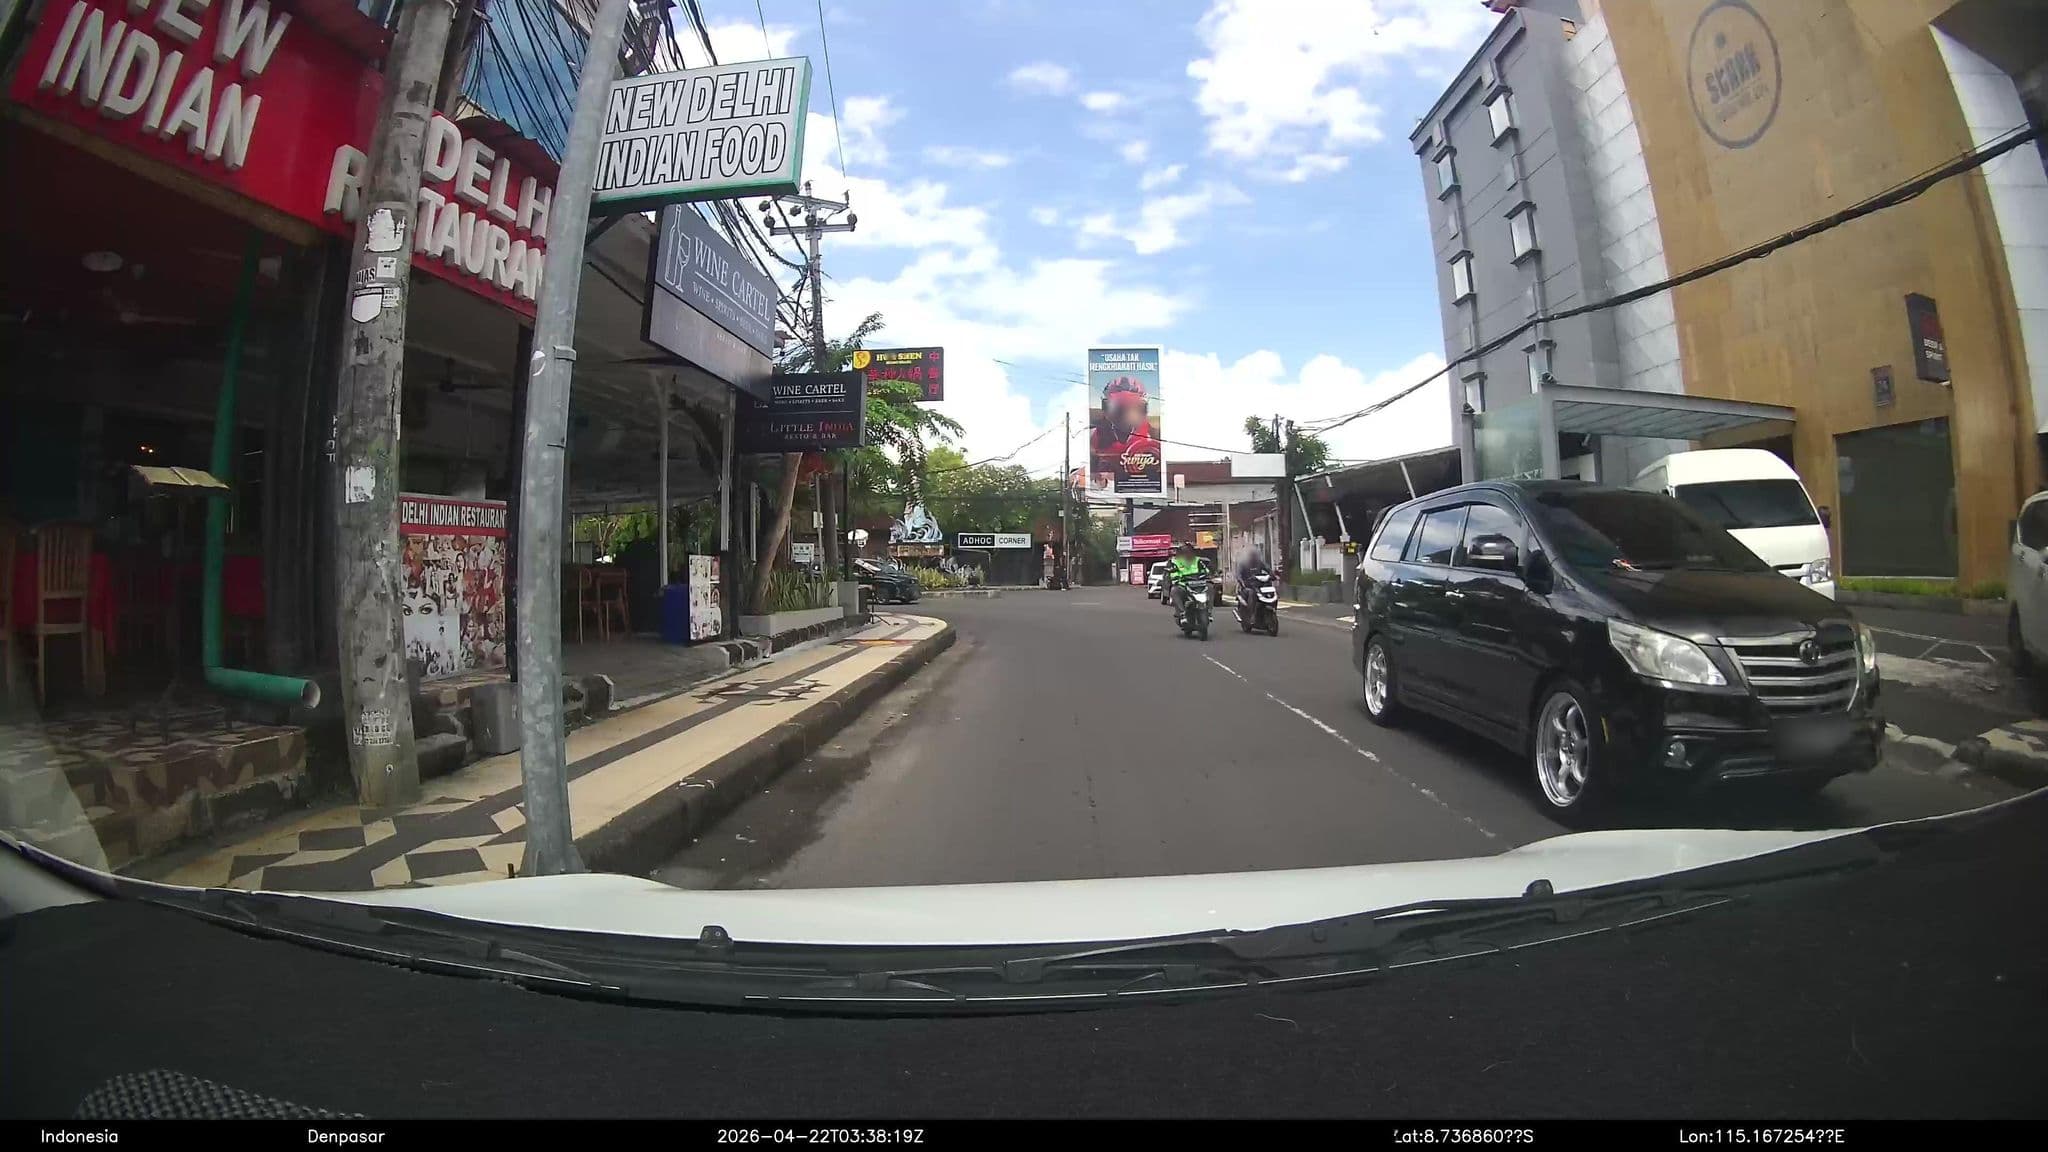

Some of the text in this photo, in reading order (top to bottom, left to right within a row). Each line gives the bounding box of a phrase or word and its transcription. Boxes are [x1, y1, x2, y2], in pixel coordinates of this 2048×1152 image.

[38, 0, 262, 170] INDIAN
[606, 67, 795, 135] NEW DELHI
[593, 122, 787, 191] INDIAN FOOD
[694, 236, 770, 322] WINE CARTEL
[773, 383, 847, 396] WINE CARTEL
[770, 420, 854, 433] LITTLE INDIA
[402, 501, 428, 525] DELHI
[428, 503, 459, 527] INDIAN
[962, 536, 1026, 546] ADHOC CORNER
